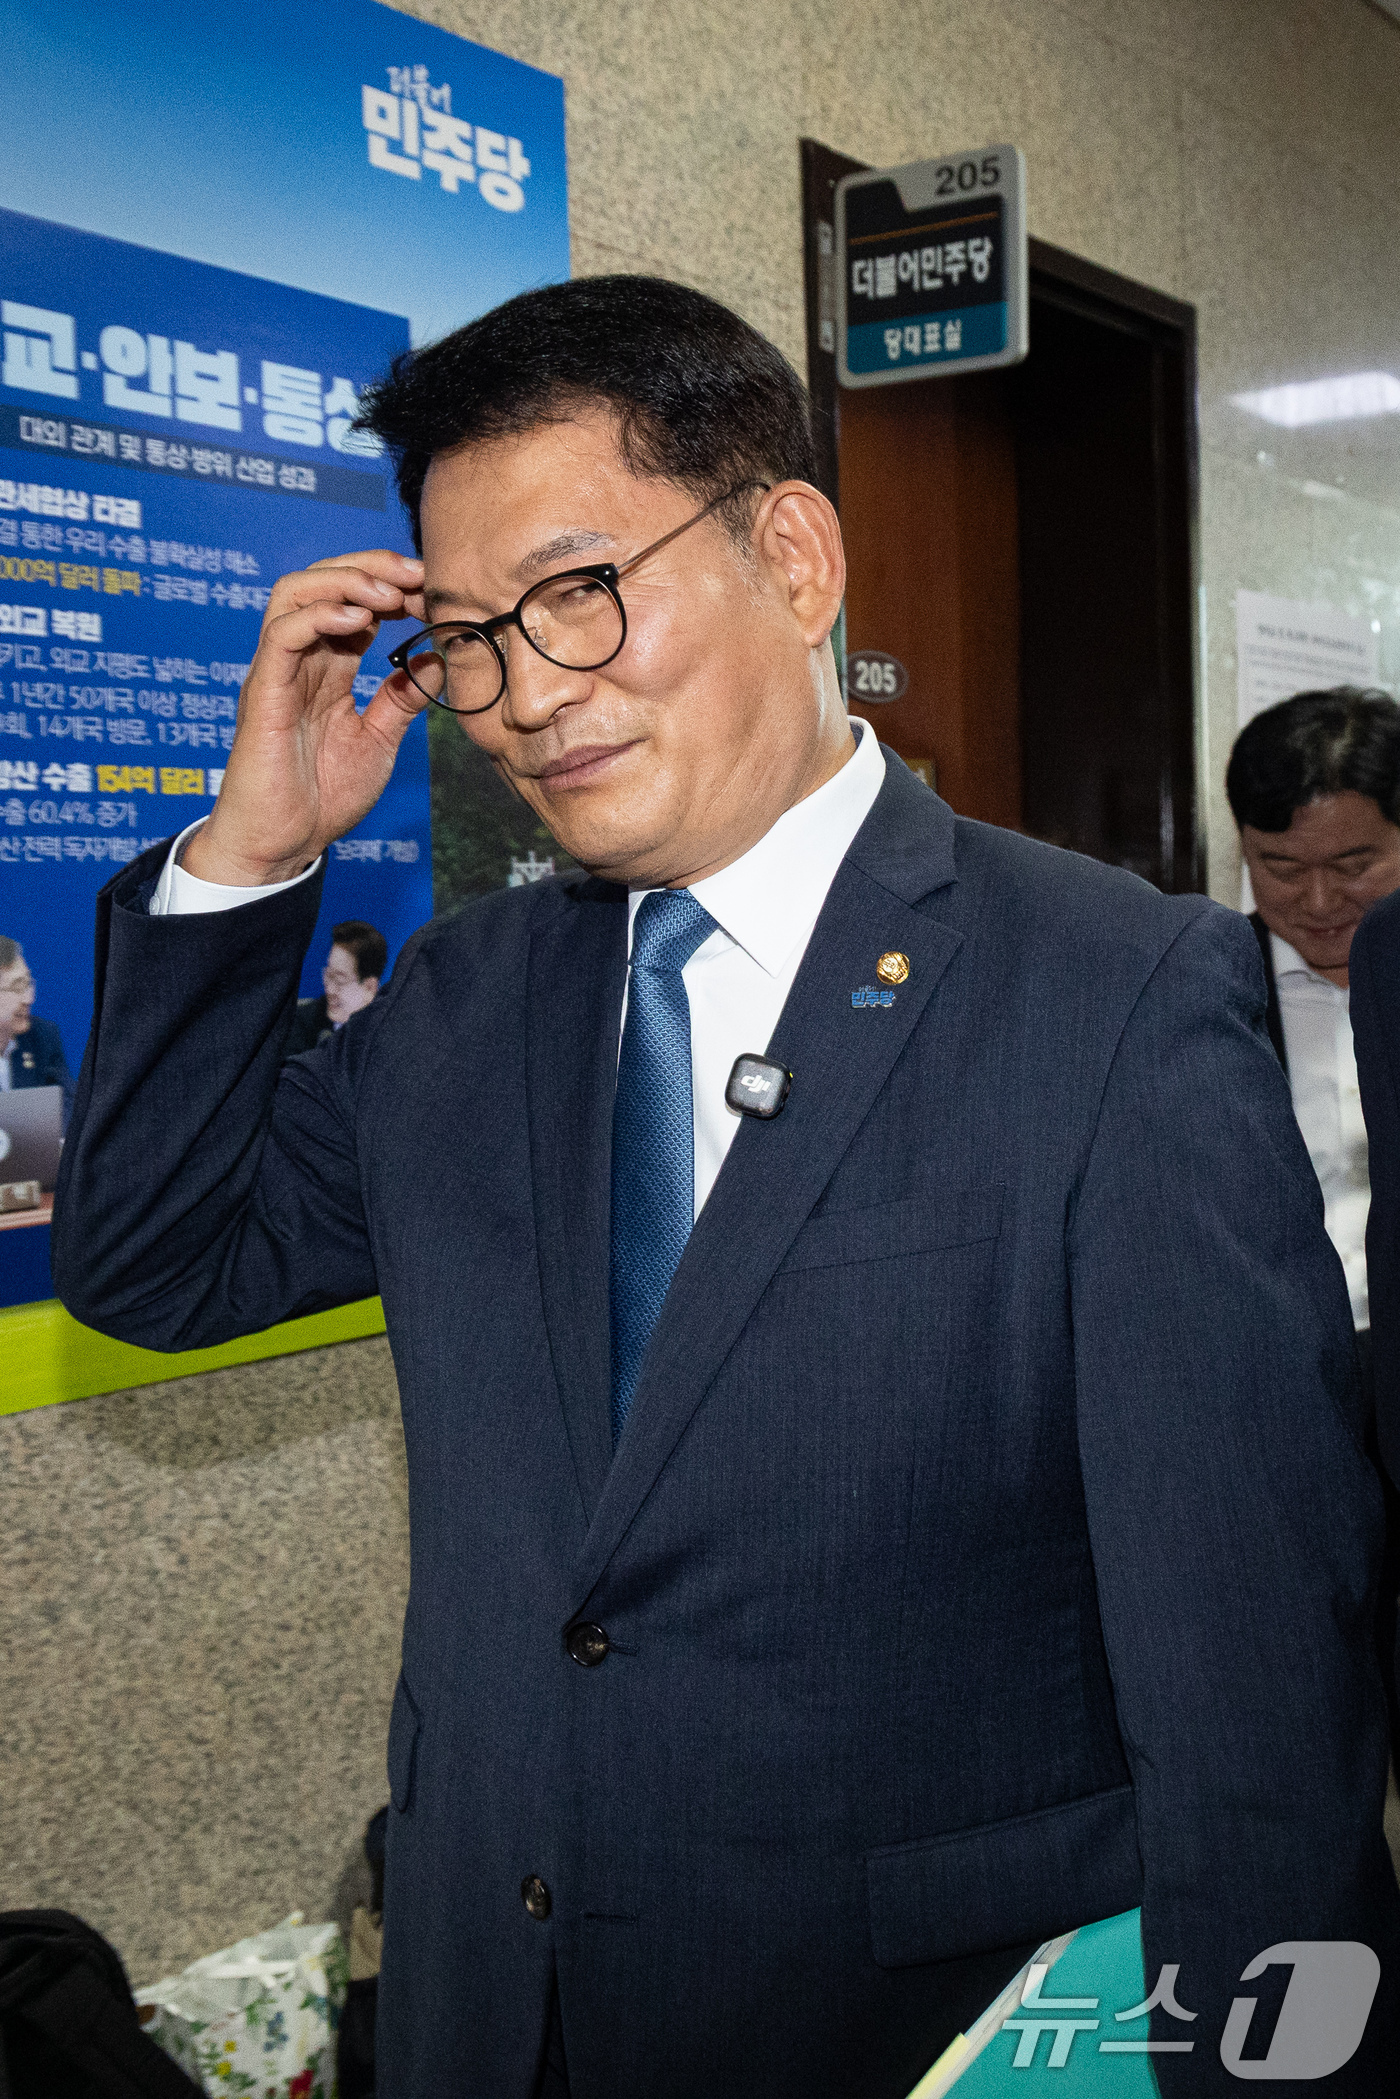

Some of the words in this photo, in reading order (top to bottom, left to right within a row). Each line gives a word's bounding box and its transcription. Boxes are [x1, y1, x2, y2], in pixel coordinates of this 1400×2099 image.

[362, 84, 530, 212] 민주당
[934, 157, 1000, 196] 205
[852, 236, 993, 300] 더불어민주당
[884, 318, 962, 360] 당대표실
[19, 415, 66, 448] 대외
[70, 424, 117, 458] 관계
[119, 433, 142, 464] 및
[236, 456, 275, 488] 산업
[279, 464, 317, 493] 성과
[93, 494, 142, 529] 타결
[21, 520, 63, 552] 통한
[65, 527, 107, 558] 우리
[108, 534, 147, 563] 수출
[58, 561, 99, 592] 달러
[154, 573, 208, 606] 글로벌
[51, 608, 102, 642] 복원
[50, 647, 91, 674] 외교
[855, 660, 897, 693] 205
[11, 681, 66, 709] 1년간
[69, 686, 134, 713] 50개국
[138, 689, 178, 718] 이상
[157, 722, 218, 748] 13개국
[41, 762, 92, 793] 수출
[159, 767, 205, 795] 달러
[96, 801, 138, 828] 증가
[851, 990, 895, 1008] 민주당
